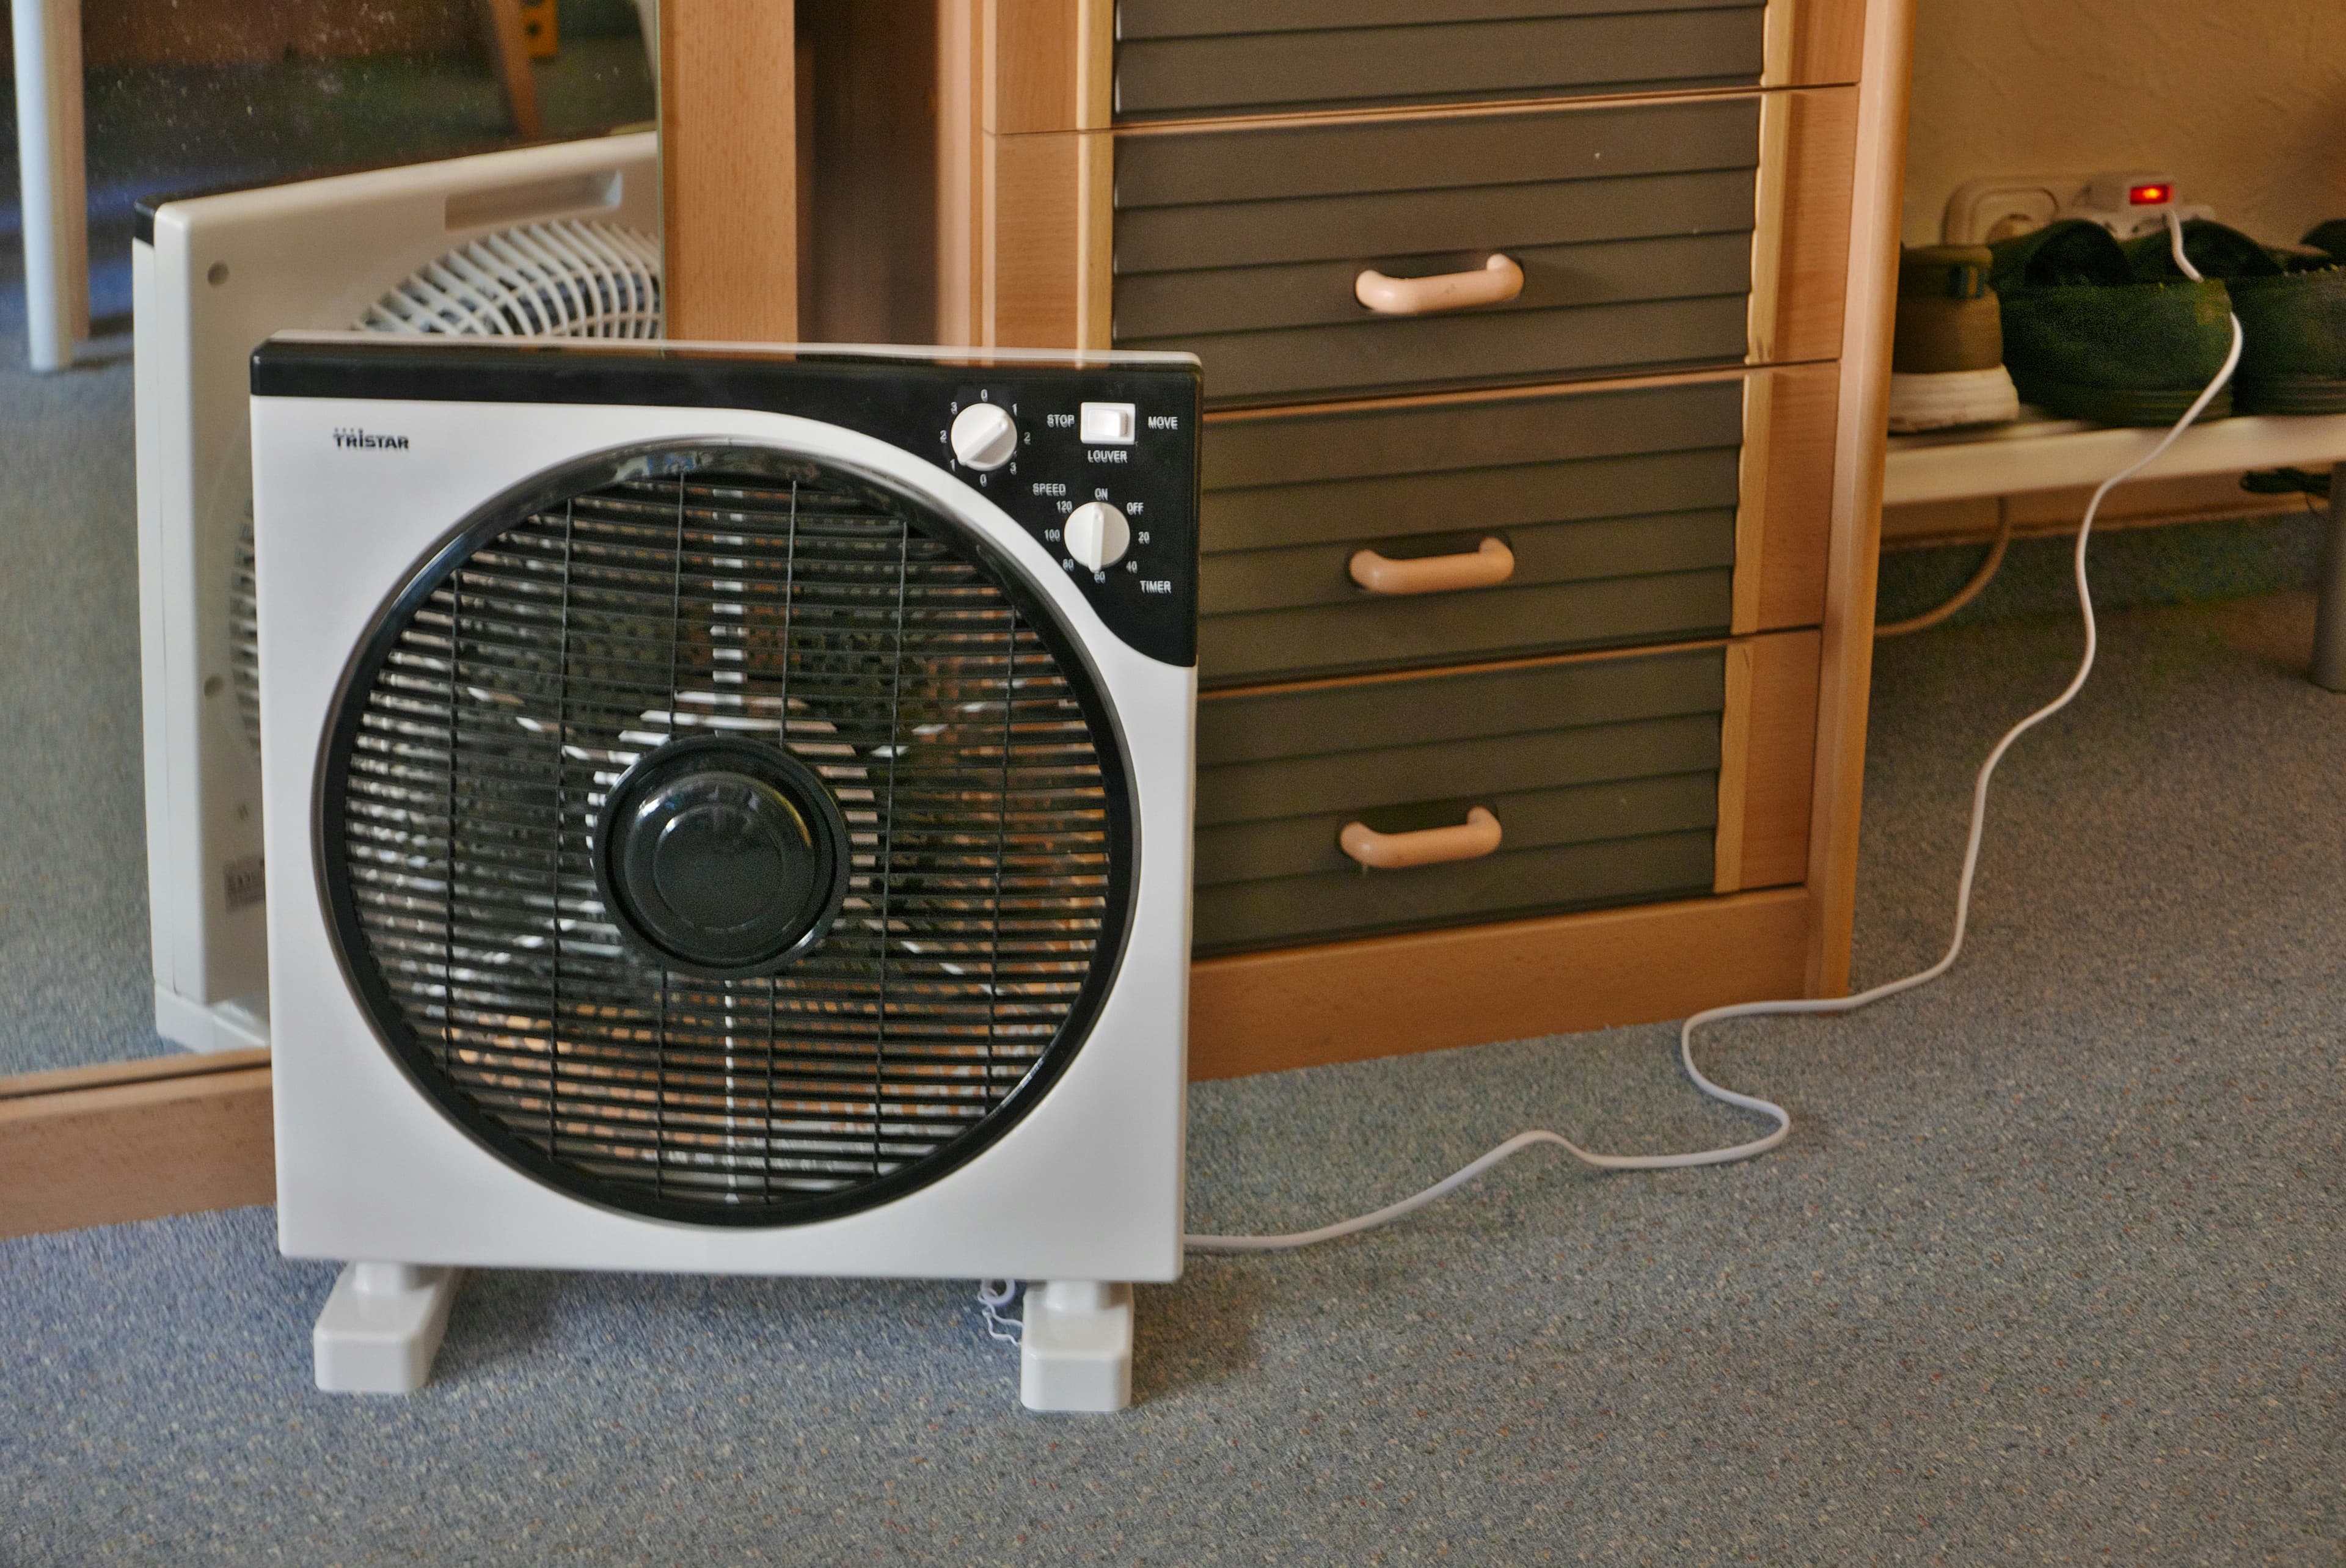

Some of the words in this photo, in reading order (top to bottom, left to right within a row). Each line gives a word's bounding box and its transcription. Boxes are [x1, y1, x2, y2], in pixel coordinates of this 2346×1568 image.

[981, 389, 988, 401] 0
[1012, 403, 1017, 416] 1
[1047, 414, 1075, 428] STOP
[1148, 417, 1178, 429] MOVE
[940, 430, 947, 443] 2
[1024, 432, 1031, 445] 2
[1087, 450, 1128, 463] LOUVER
[950, 459, 956, 472] 1
[980, 474, 987, 487] 0
[1032, 483, 1066, 496] SPEED
[1095, 488, 1108, 500] ON
[1056, 501, 1072, 514] 120
[1127, 502, 1144, 515] OFF
[1044, 530, 1060, 542] 100
[1138, 532, 1150, 544] 20
[1062, 559, 1074, 571] 80
[1127, 561, 1138, 573] 40
[1140, 580, 1171, 594] TIMER
